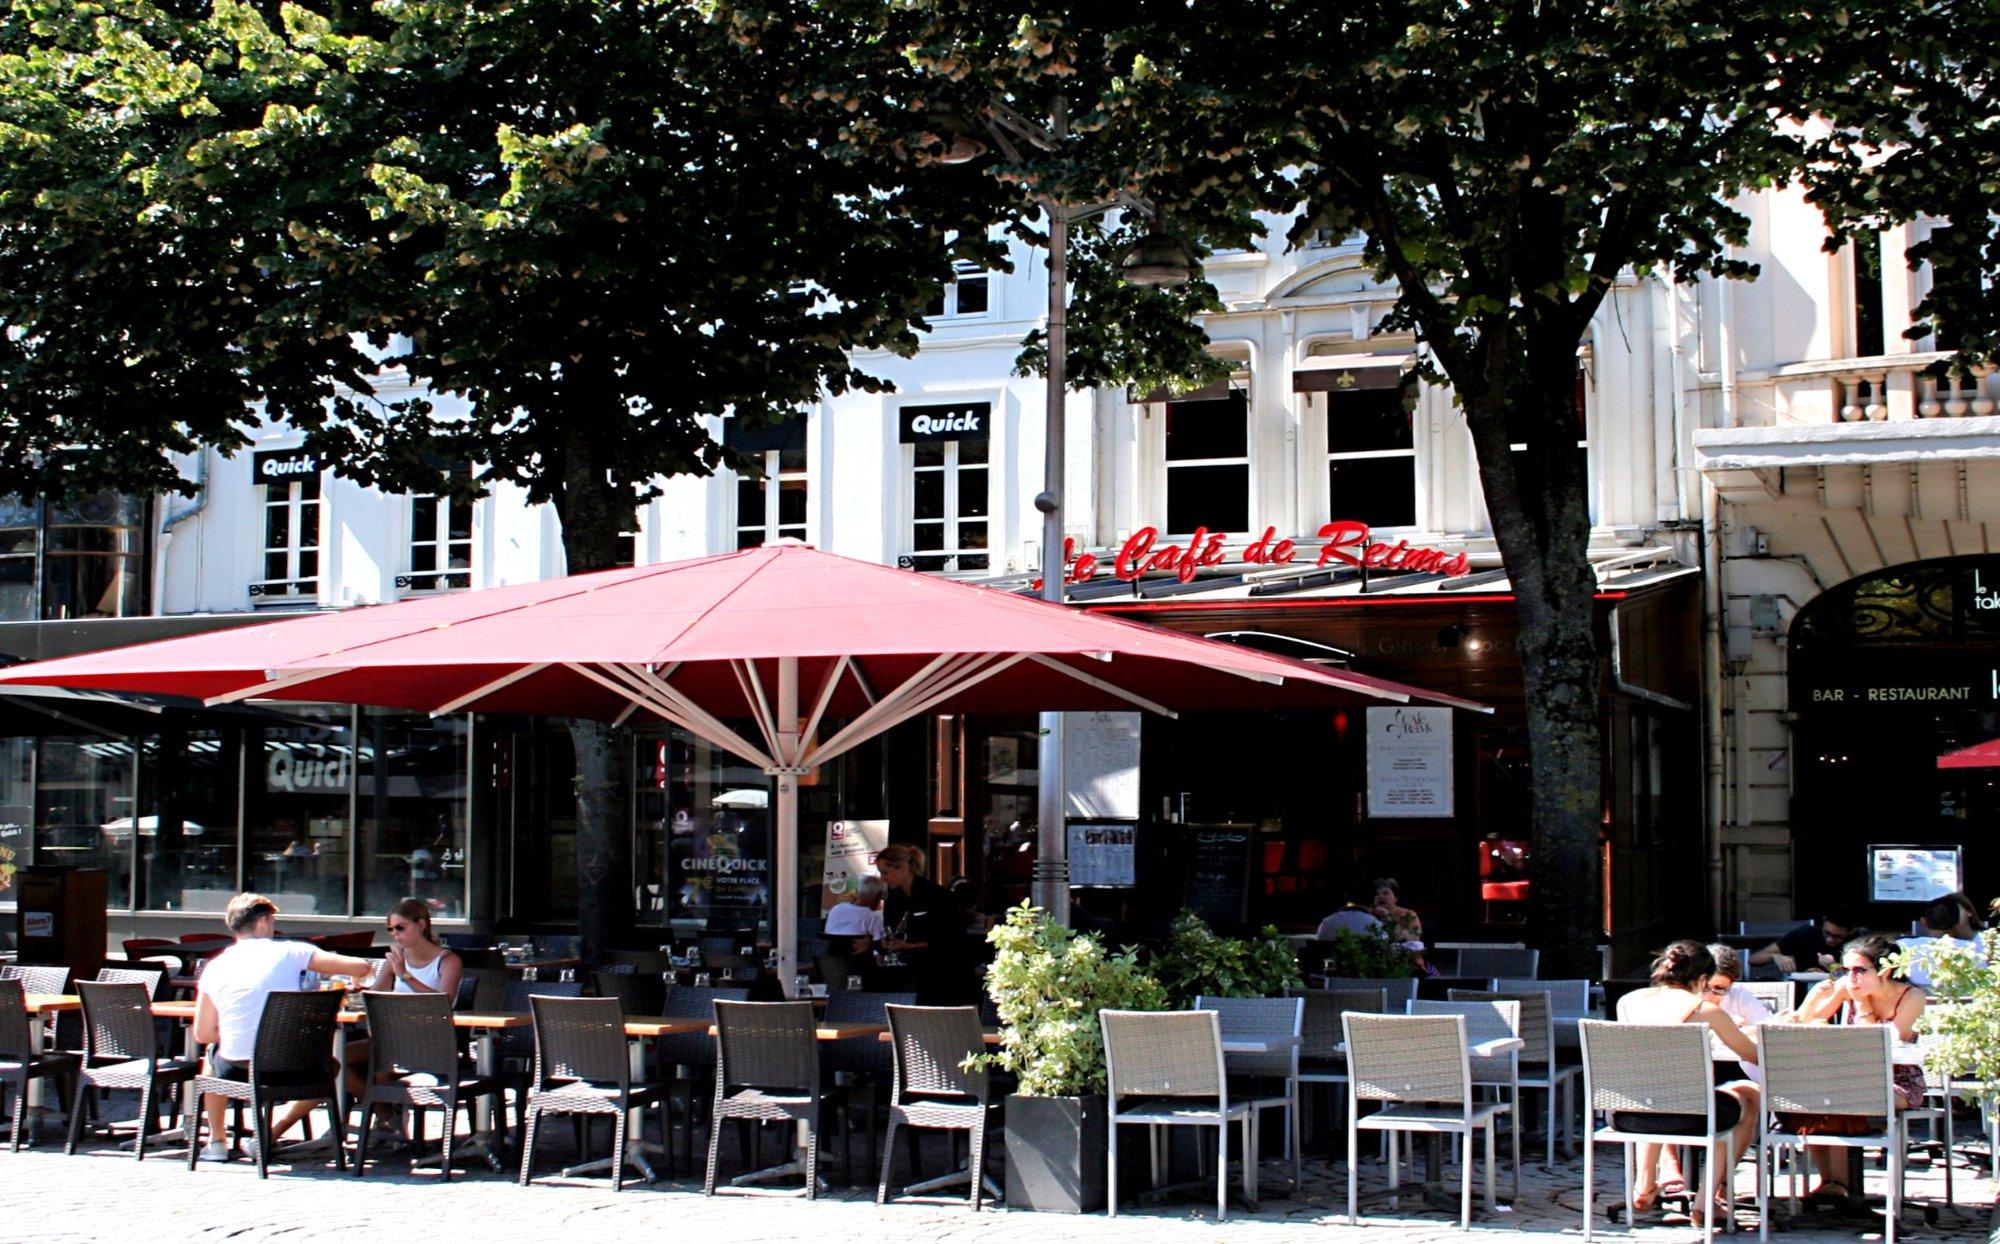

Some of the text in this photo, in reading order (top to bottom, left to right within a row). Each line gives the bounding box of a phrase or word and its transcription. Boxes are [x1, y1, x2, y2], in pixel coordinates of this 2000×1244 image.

[911, 409, 981, 435] Quick
[262, 454, 316, 477] Quick
[1115, 526, 1226, 584] Café
[1243, 525, 1297, 566] de
[1317, 520, 1471, 577] Reims
[1812, 688, 1844, 702] BAR
[1867, 686, 1971, 701] RESTAURANT
